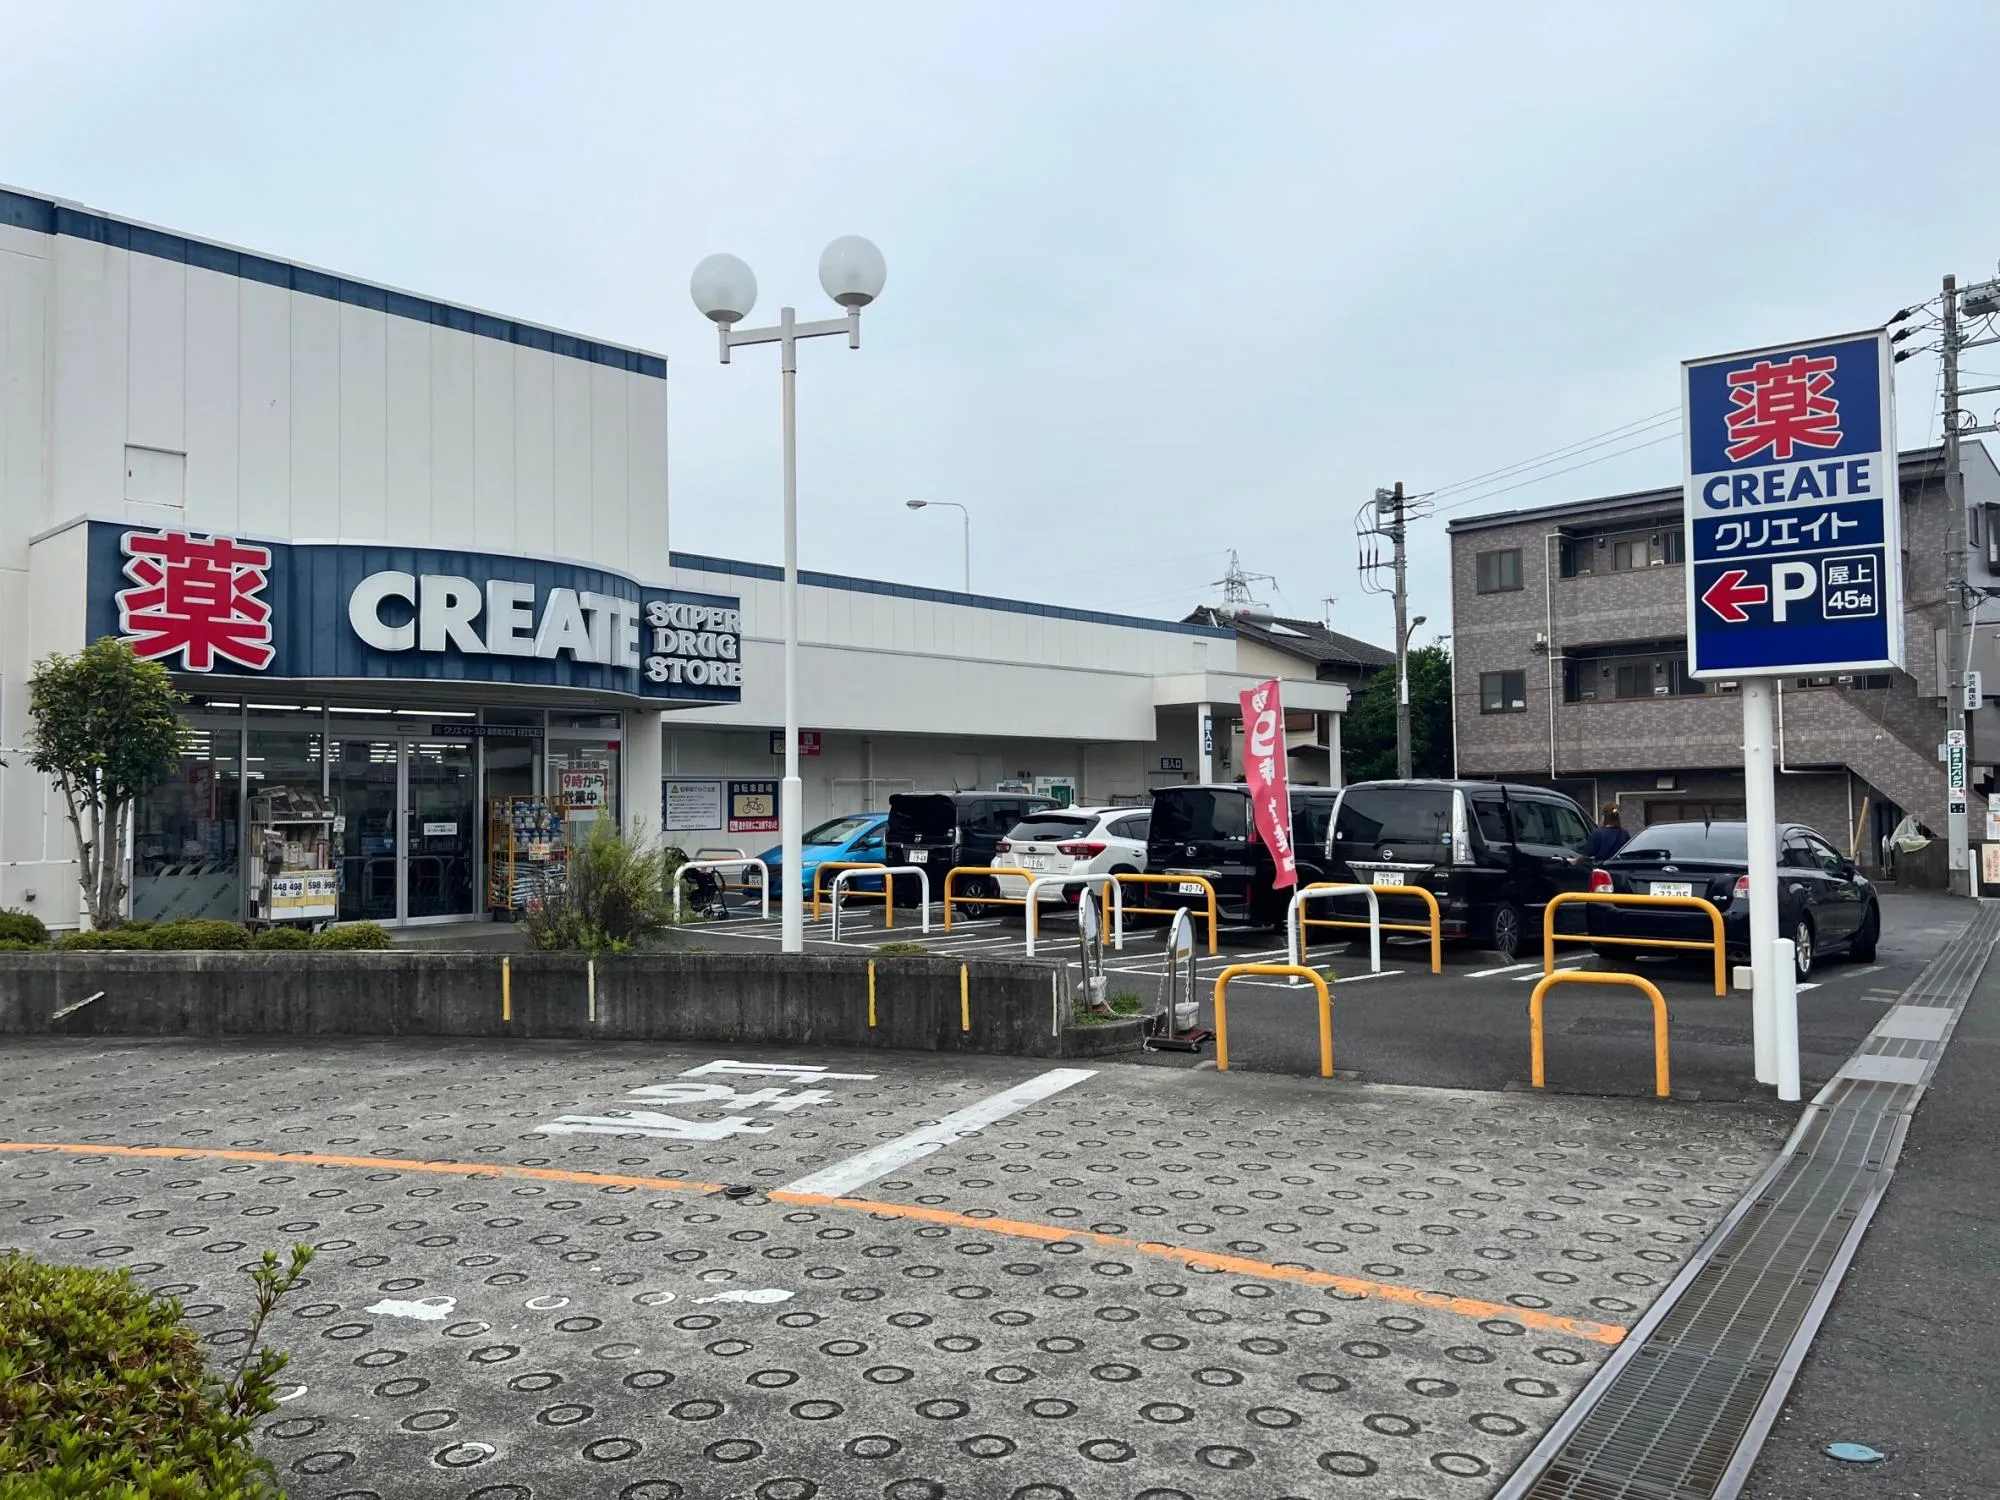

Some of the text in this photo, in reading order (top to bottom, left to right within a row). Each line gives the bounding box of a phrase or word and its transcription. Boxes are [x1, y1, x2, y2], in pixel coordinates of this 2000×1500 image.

[1724, 355, 1843, 462] 薬
[1703, 458, 1870, 510] CREATE
[1715, 511, 1858, 551] クリエイト
[1828, 566, 1872, 586] 屋上
[115, 529, 275, 672] 薬
[1772, 561, 1817, 623] P
[1827, 589, 1872, 611] 45台
[349, 570, 640, 669] CREATE
[645, 600, 741, 633] SUPER
[652, 628, 737, 659] DRUG
[644, 656, 742, 687] STORE
[564, 775, 604, 788] 9時から
[733, 783, 773, 793] 自転車置場
[272, 882, 287, 891] 448
[289, 882, 302, 891] 498
